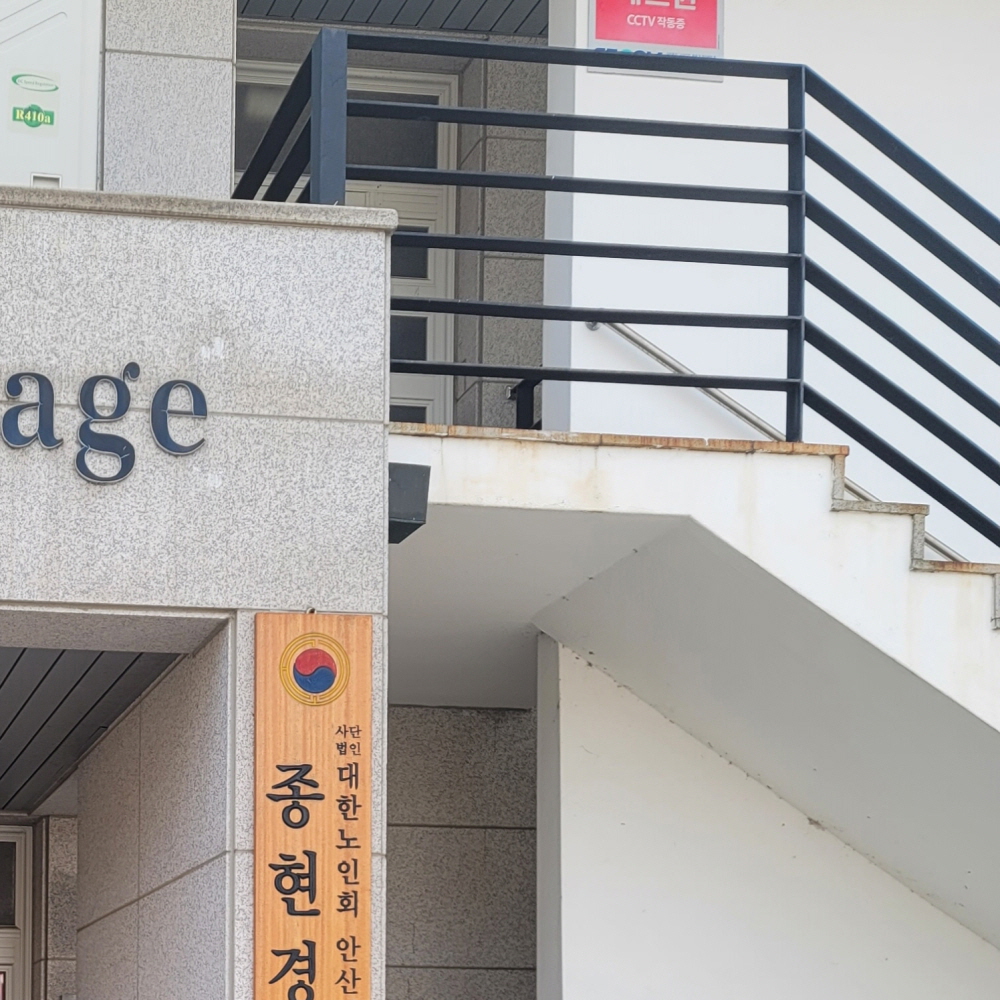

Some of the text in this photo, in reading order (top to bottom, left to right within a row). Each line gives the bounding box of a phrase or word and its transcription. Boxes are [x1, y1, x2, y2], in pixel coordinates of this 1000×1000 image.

[626, 13, 686, 30] CCTV 작동중
[15, 108, 52, 124] R410a
[335, 724, 362, 739] 사단
[335, 741, 362, 756] 법인
[334, 761, 362, 919] 대한노인회
